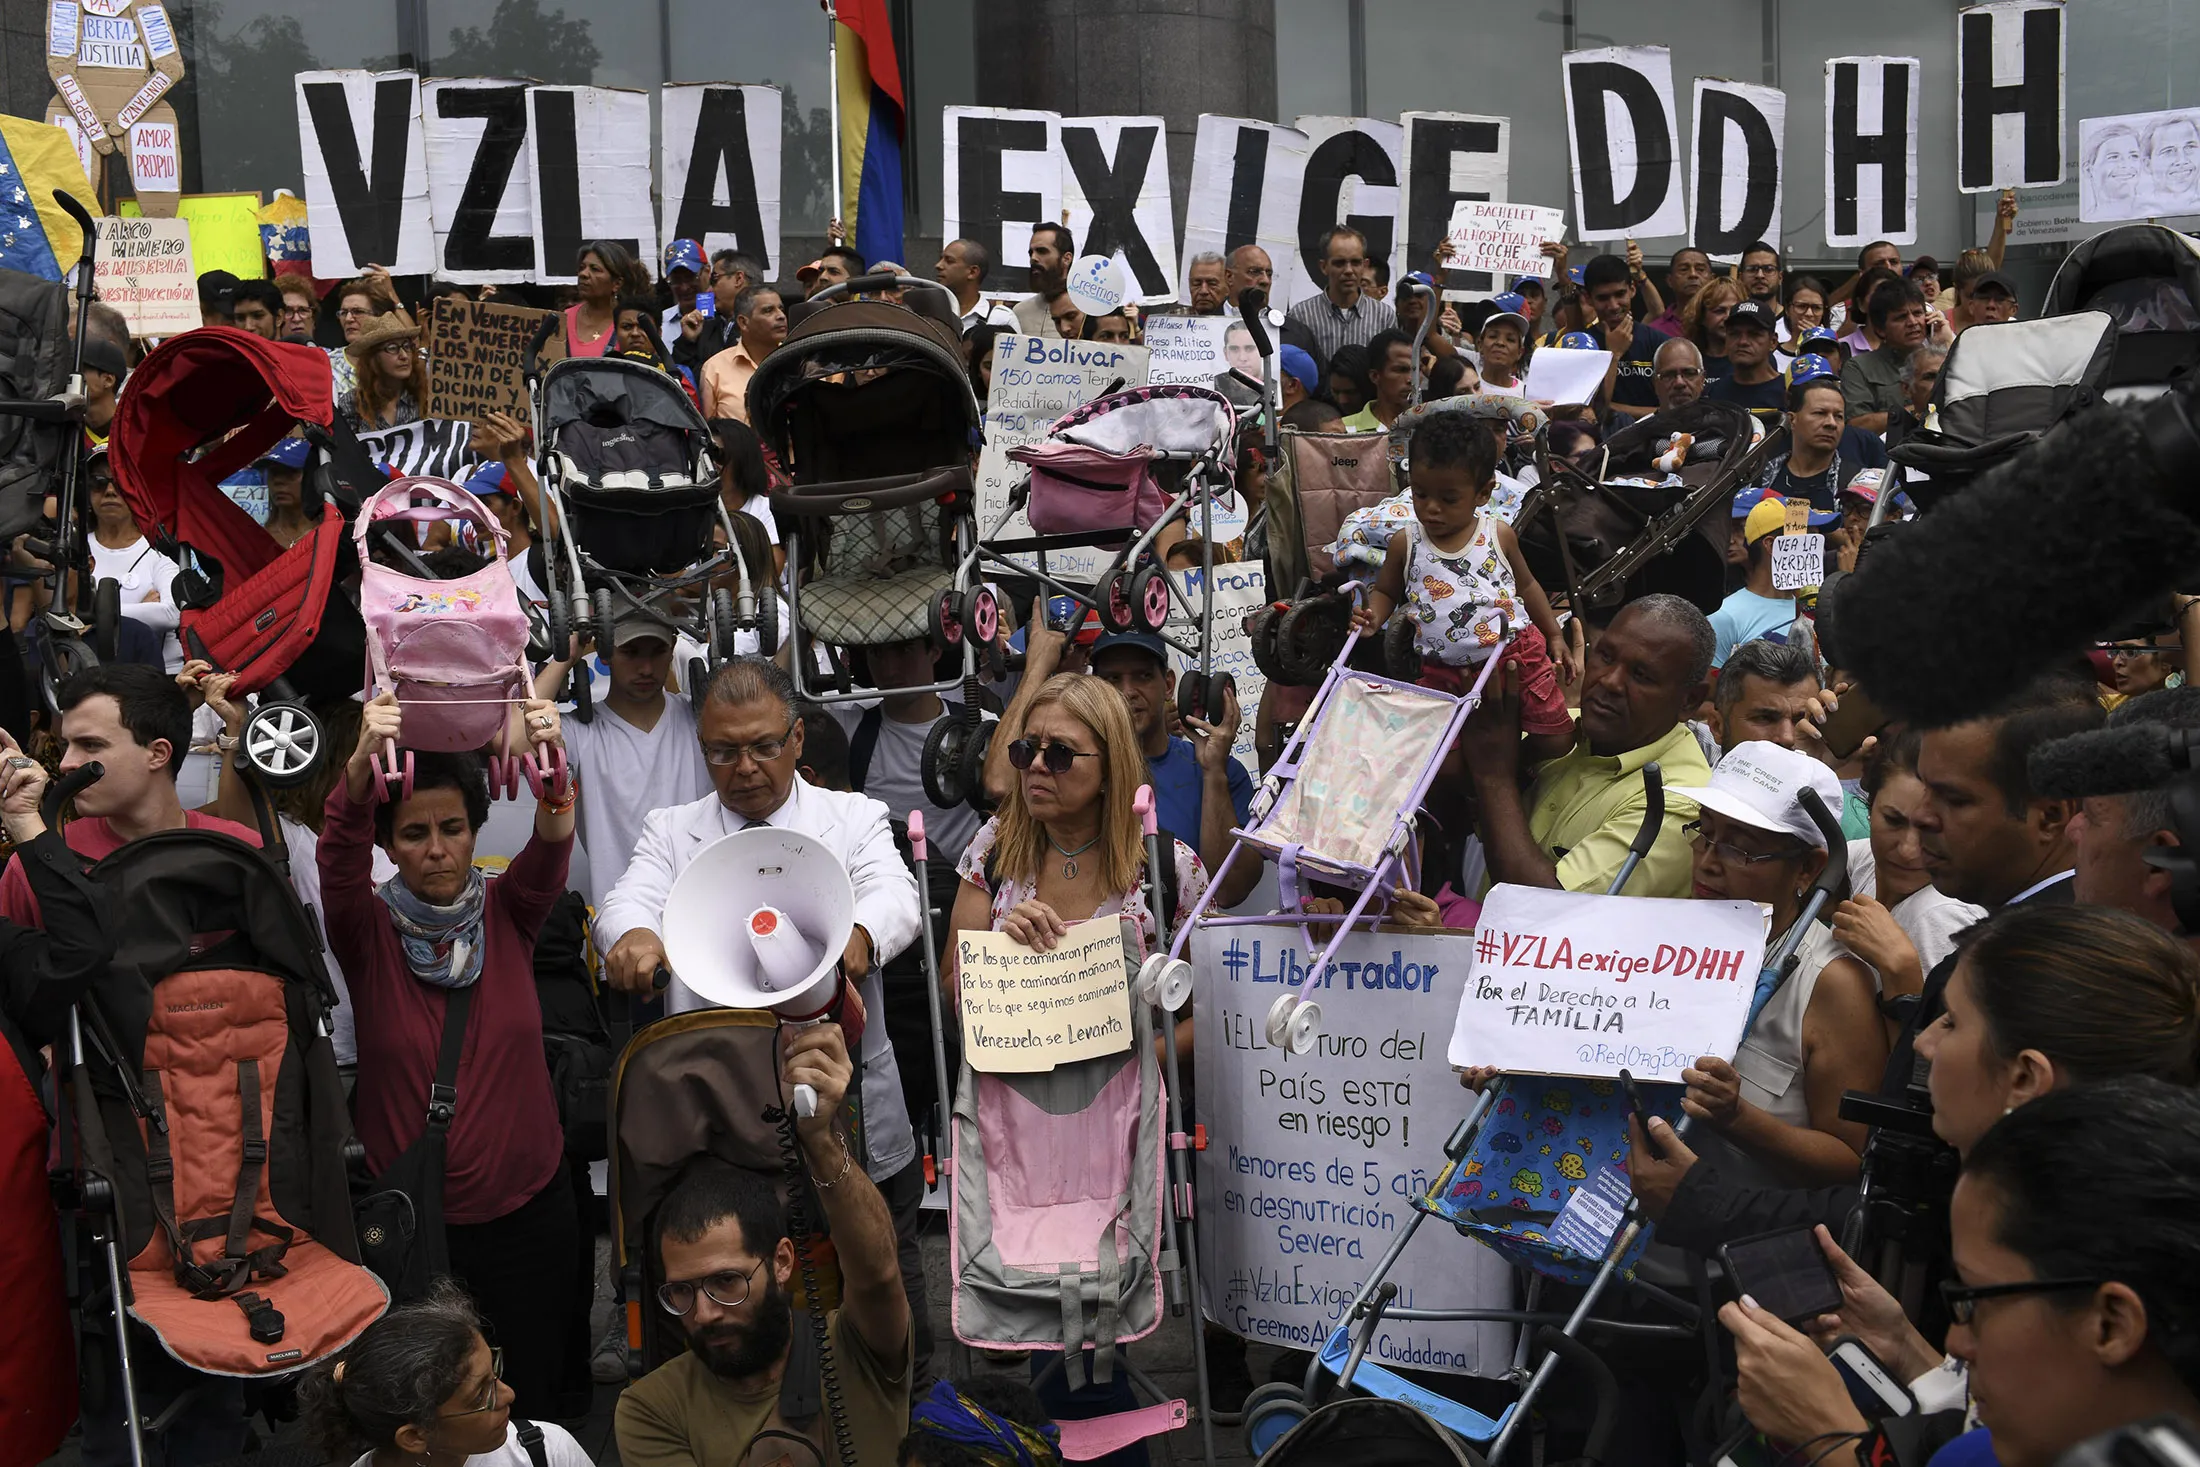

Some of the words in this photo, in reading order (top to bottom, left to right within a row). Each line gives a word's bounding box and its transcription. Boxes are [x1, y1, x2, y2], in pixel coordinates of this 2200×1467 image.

[61, 79, 103, 138] RESPETO
[121, 76, 168, 124] CONFIANZA
[137, 129, 172, 149] AMOR
[136, 154, 175, 178] PROPIO
[1475, 205, 1537, 221] BACHELET
[106, 221, 152, 240] ARCO
[1496, 219, 1513, 231] VE
[2028, 227, 2068, 236] Venezuela
[1454, 228, 1468, 240] AL
[1471, 229, 1528, 246] HOSPITAL
[112, 239, 184, 258] MINERO
[111, 258, 188, 276] MISERIA
[99, 282, 194, 302] DESTRUCCIÓN
[1071, 272, 1120, 304] Creemos
[436, 300, 466, 323] EN
[436, 324, 461, 340] SE
[433, 339, 468, 359] LOS
[432, 359, 484, 381] FALTA
[490, 367, 513, 385] DE
[1000, 368, 1032, 386] 150
[1036, 372, 1082, 386] camas
[432, 378, 497, 400] DICINA
[507, 388, 518, 404] Y
[996, 412, 1026, 431] 150
[1331, 456, 1358, 467] Jeep
[1777, 538, 1799, 552] VEA
[1773, 554, 1820, 571] VERDAD
[1773, 571, 1822, 588] BACHELET
[1752, 776, 1780, 794] CAMP
[1754, 766, 1784, 786] CREST
[960, 940, 980, 965] Por
[983, 946, 998, 965] los
[1000, 954, 1020, 972] que
[1023, 948, 1081, 965] caminaron
[1082, 934, 1121, 962] primero
[1475, 928, 1745, 983] #VZLAexigeDDHH
[962, 972, 976, 990] Por
[997, 979, 1016, 995] que
[1020, 970, 1077, 989] caminarán
[1078, 958, 1122, 981] mañana
[965, 999, 984, 1015] Por
[988, 1000, 1002, 1014] los
[1005, 1003, 1023, 1017] que
[1027, 994, 1075, 1015] seguimos
[1077, 980, 1126, 1003] caminando
[1511, 981, 1527, 1001] el
[1538, 982, 1618, 1009] Derecho
[1624, 997, 1637, 1009] a
[1648, 991, 1671, 1010] la
[167, 1001, 224, 1013] MACLAREN
[972, 1025, 1043, 1049] Venezuela
[1045, 1032, 1063, 1045] se
[1067, 1015, 1123, 1045] Levanta
[1380, 1028, 1426, 1061] del
[1259, 1068, 1327, 1105] País
[1278, 1110, 1308, 1134] en
[1316, 1110, 1391, 1148] riesgo
[1228, 1145, 1317, 1183] Menores
[1326, 1157, 1354, 1186] de
[1362, 1161, 1381, 1196] 5
[1225, 1189, 1245, 1215] en
[1278, 1225, 1364, 1259] Severa
[1235, 1305, 1308, 1343] Creemos
[1379, 1334, 1467, 1368] Ciudadana
